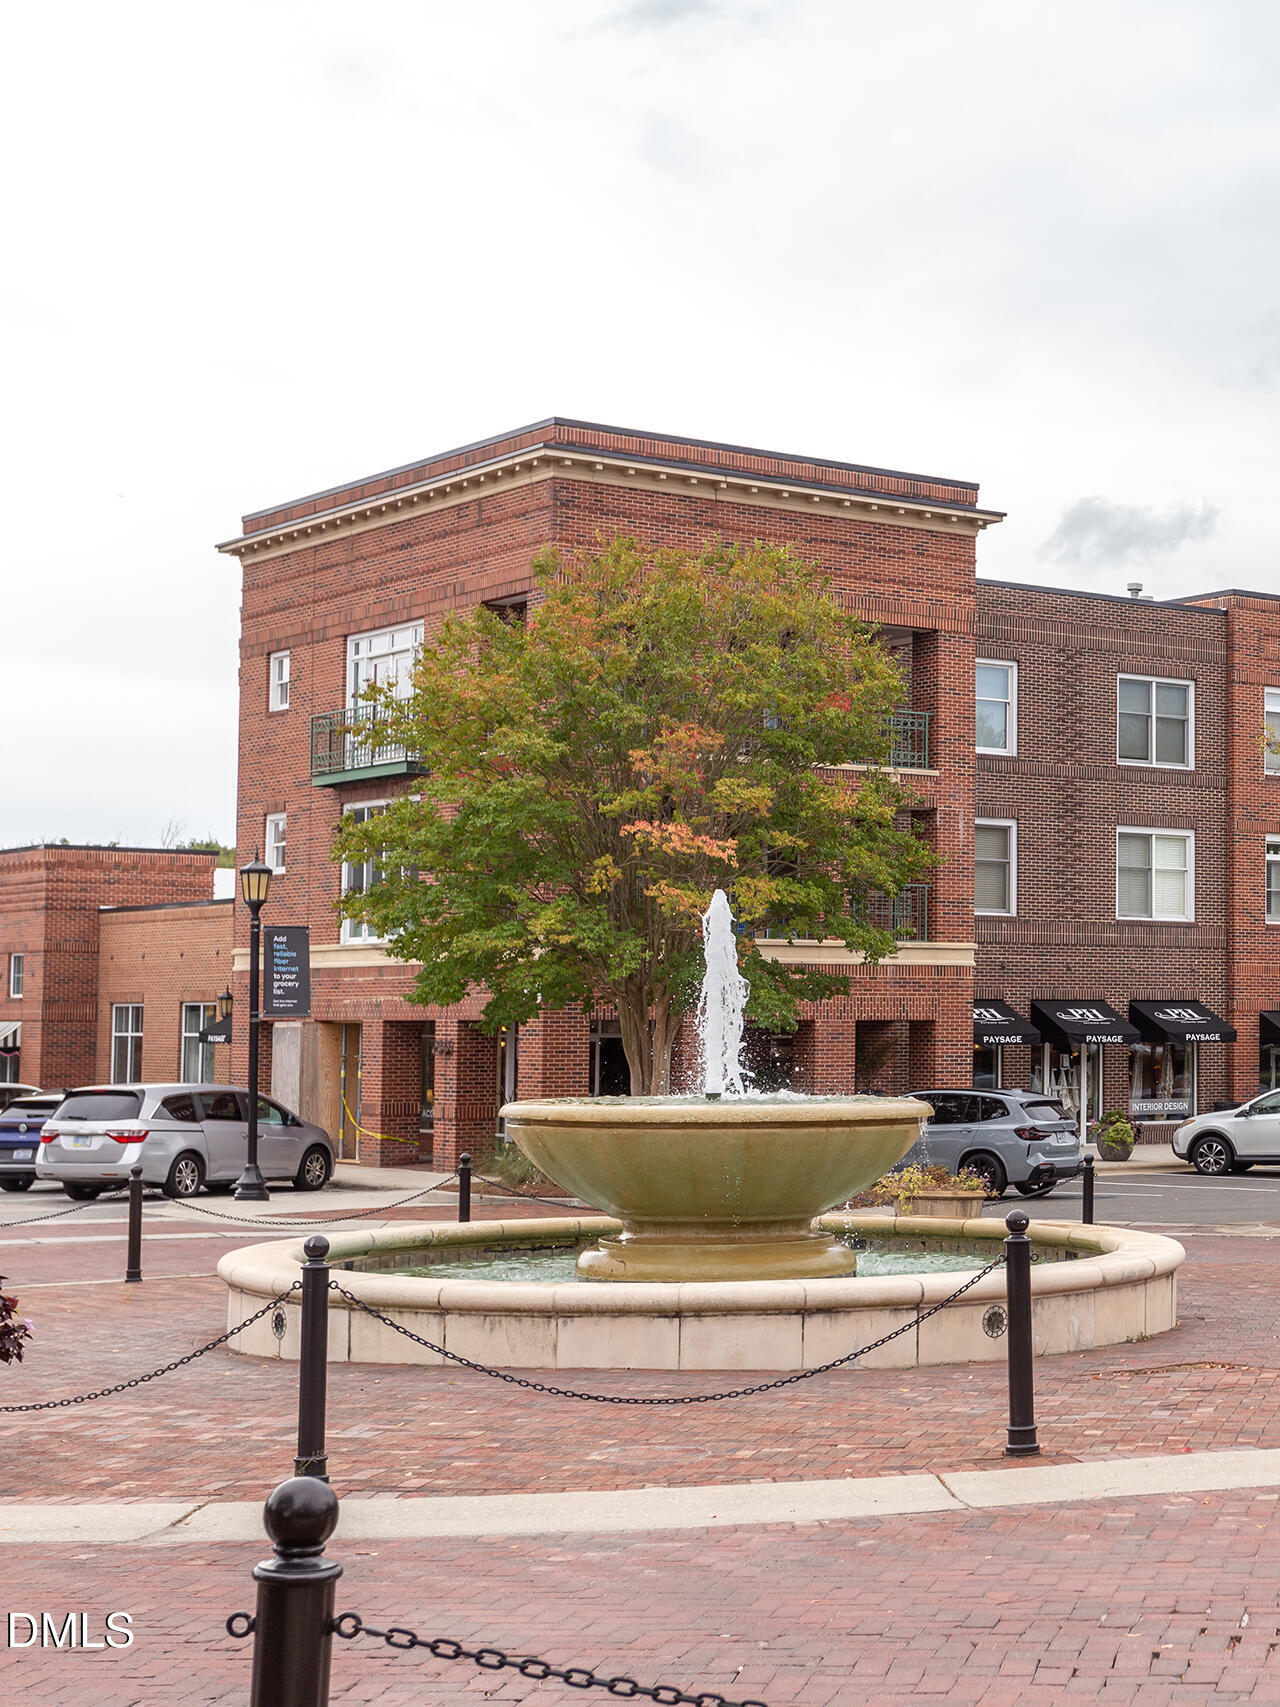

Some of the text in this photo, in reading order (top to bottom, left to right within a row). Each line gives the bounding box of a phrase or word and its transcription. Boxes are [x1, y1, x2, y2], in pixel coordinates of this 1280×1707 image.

[273, 935, 287, 943] Add
[273, 950, 297, 958] reliable
[273, 981, 299, 989] grocery
[983, 1035, 1023, 1044] PAYSAGE
[1085, 1035, 1124, 1043] PAYSAGE
[1185, 1033, 1221, 1041] PAYSAGE
[1132, 1102, 1189, 1111] INTERIOR DESIGN
